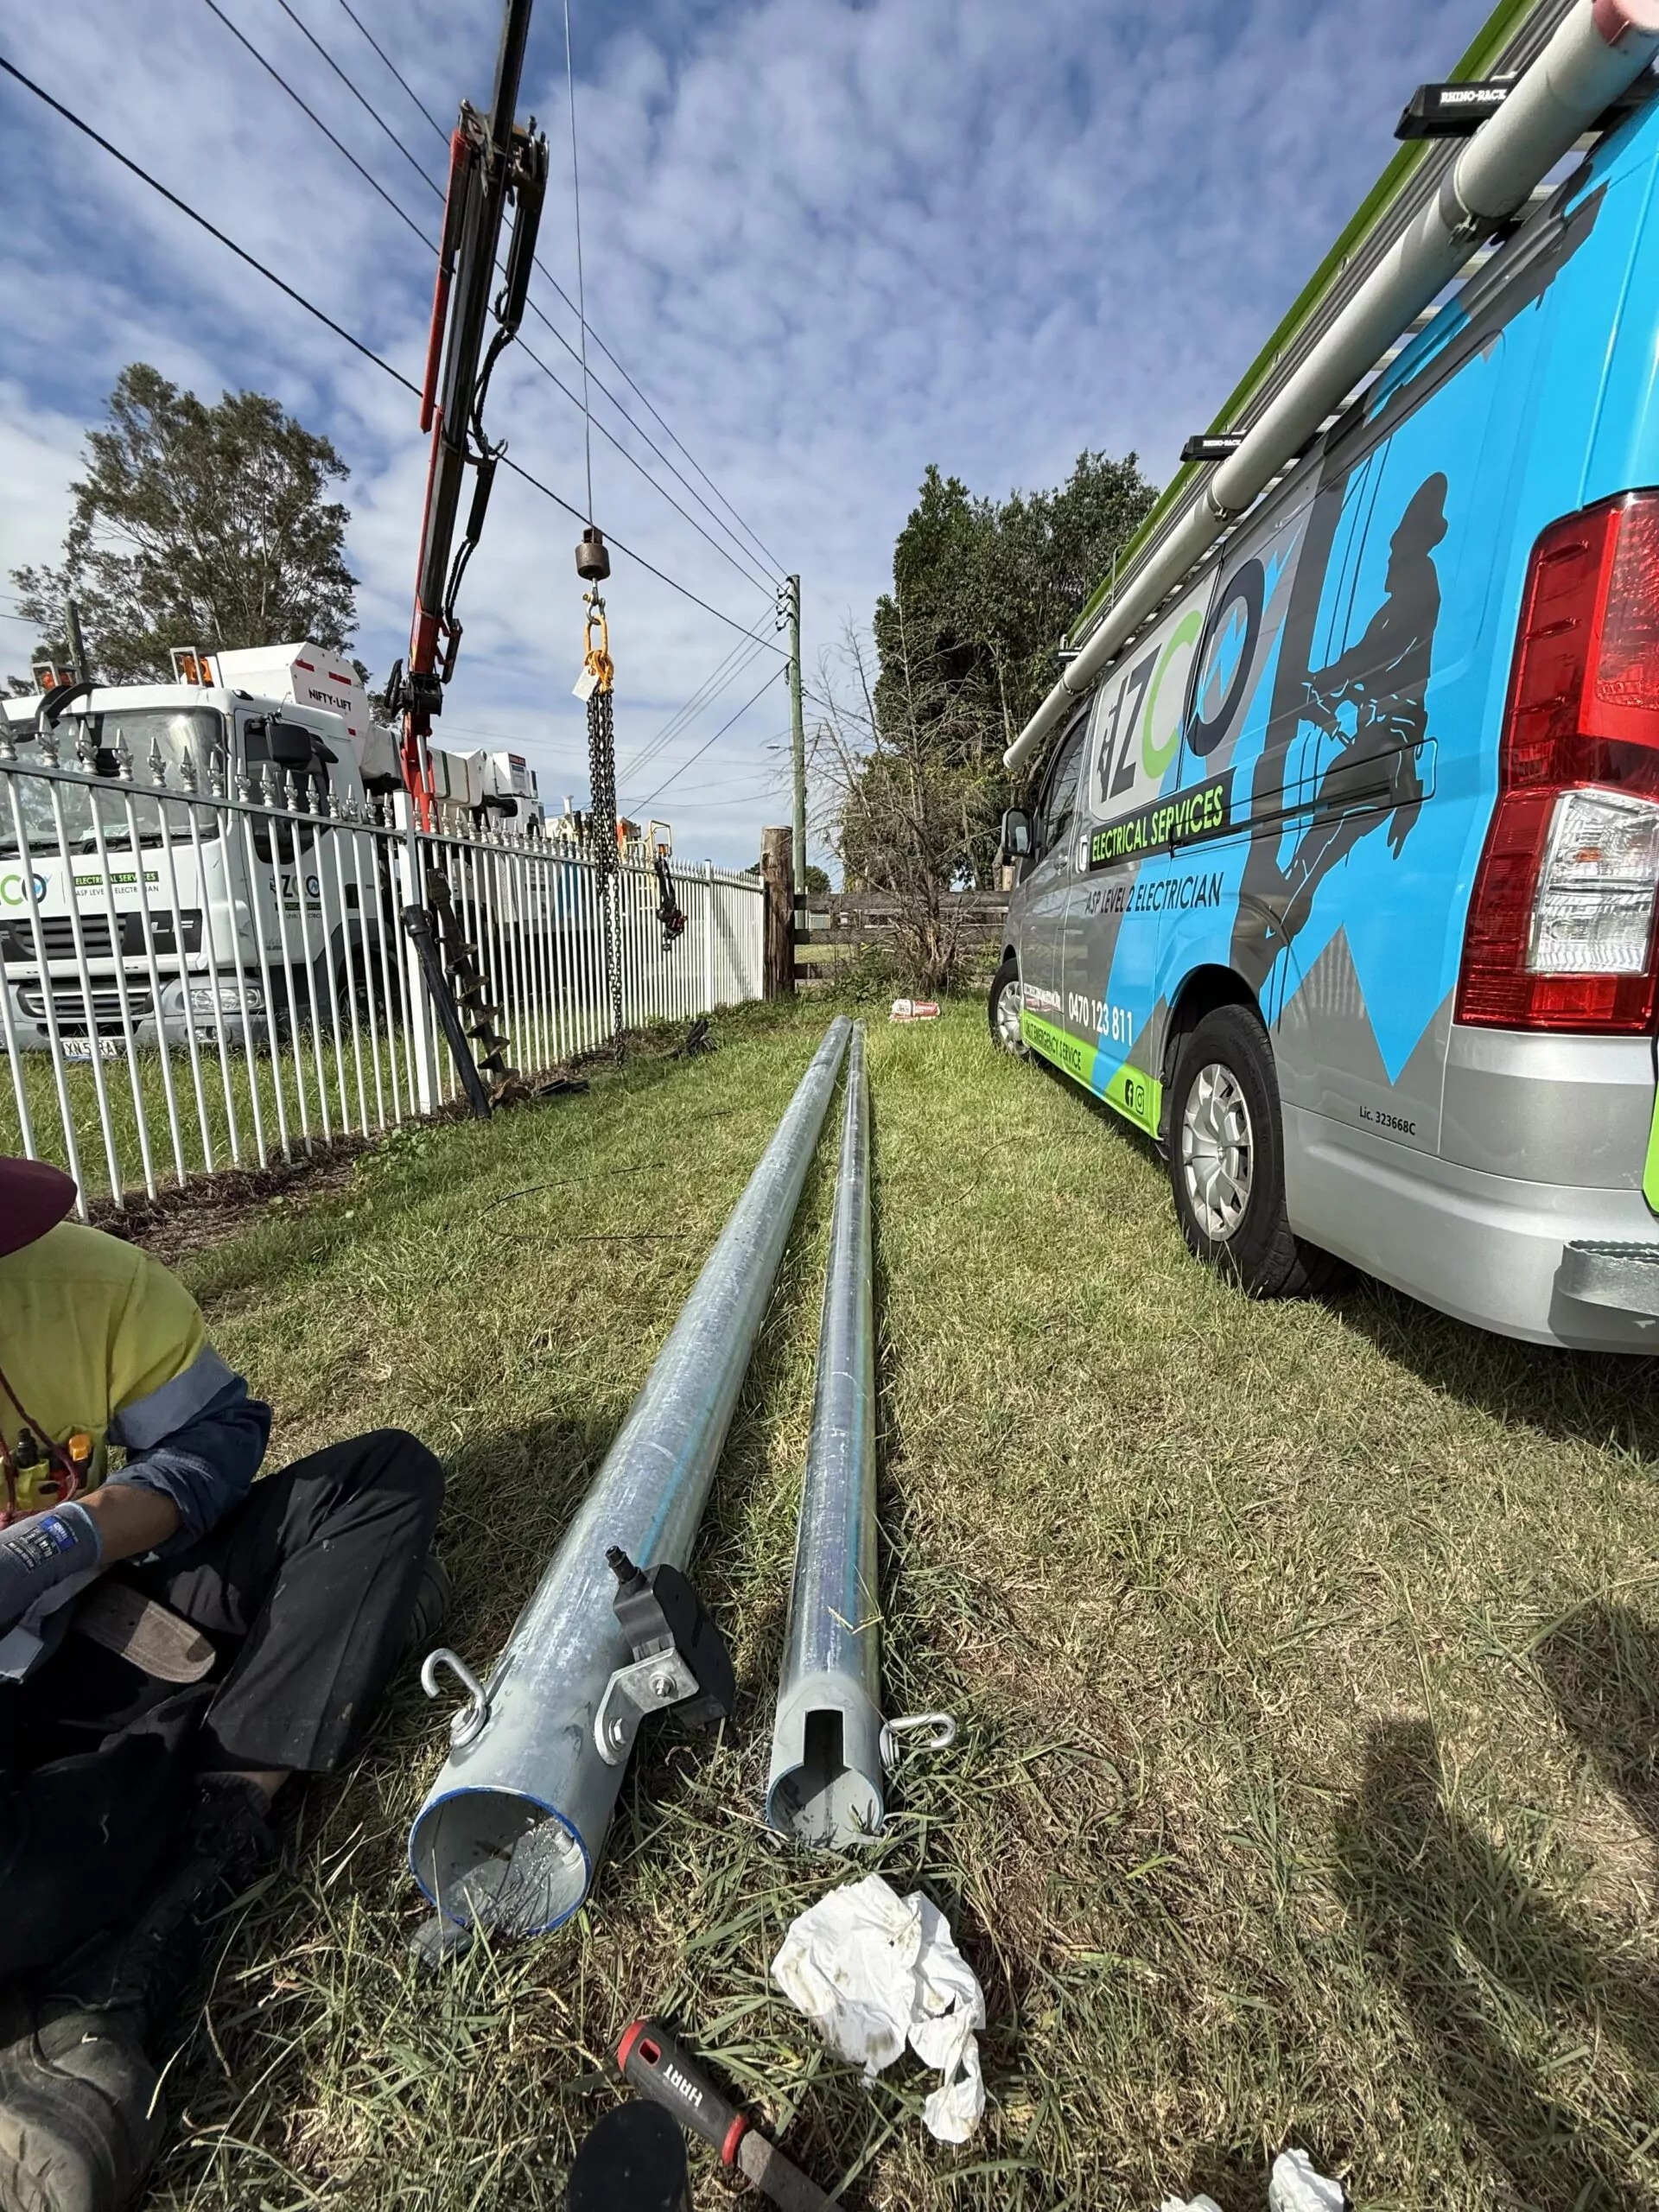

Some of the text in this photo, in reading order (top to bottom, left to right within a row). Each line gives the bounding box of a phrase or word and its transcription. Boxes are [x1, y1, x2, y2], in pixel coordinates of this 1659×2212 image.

[1440, 88, 1508, 104] RHINO-RACK
[308, 688, 352, 711] NIFTY-LIFT
[1091, 785, 1224, 862] ELECTRICAL SERVICES
[0, 874, 48, 906] CO
[75, 873, 156, 886] ELECTRIAL SERVES
[1085, 871, 1225, 914] ASP LEVEL 2 ELECTRICIAN
[1068, 991, 1090, 1027] 0470
[1091, 999, 1110, 1036] 123
[1111, 1005, 1133, 1046] 811
[1059, 1041, 1082, 1071] SERVICE
[1359, 1105, 1416, 1135] Lic. 323668C
[663, 2063, 703, 2107] HART
